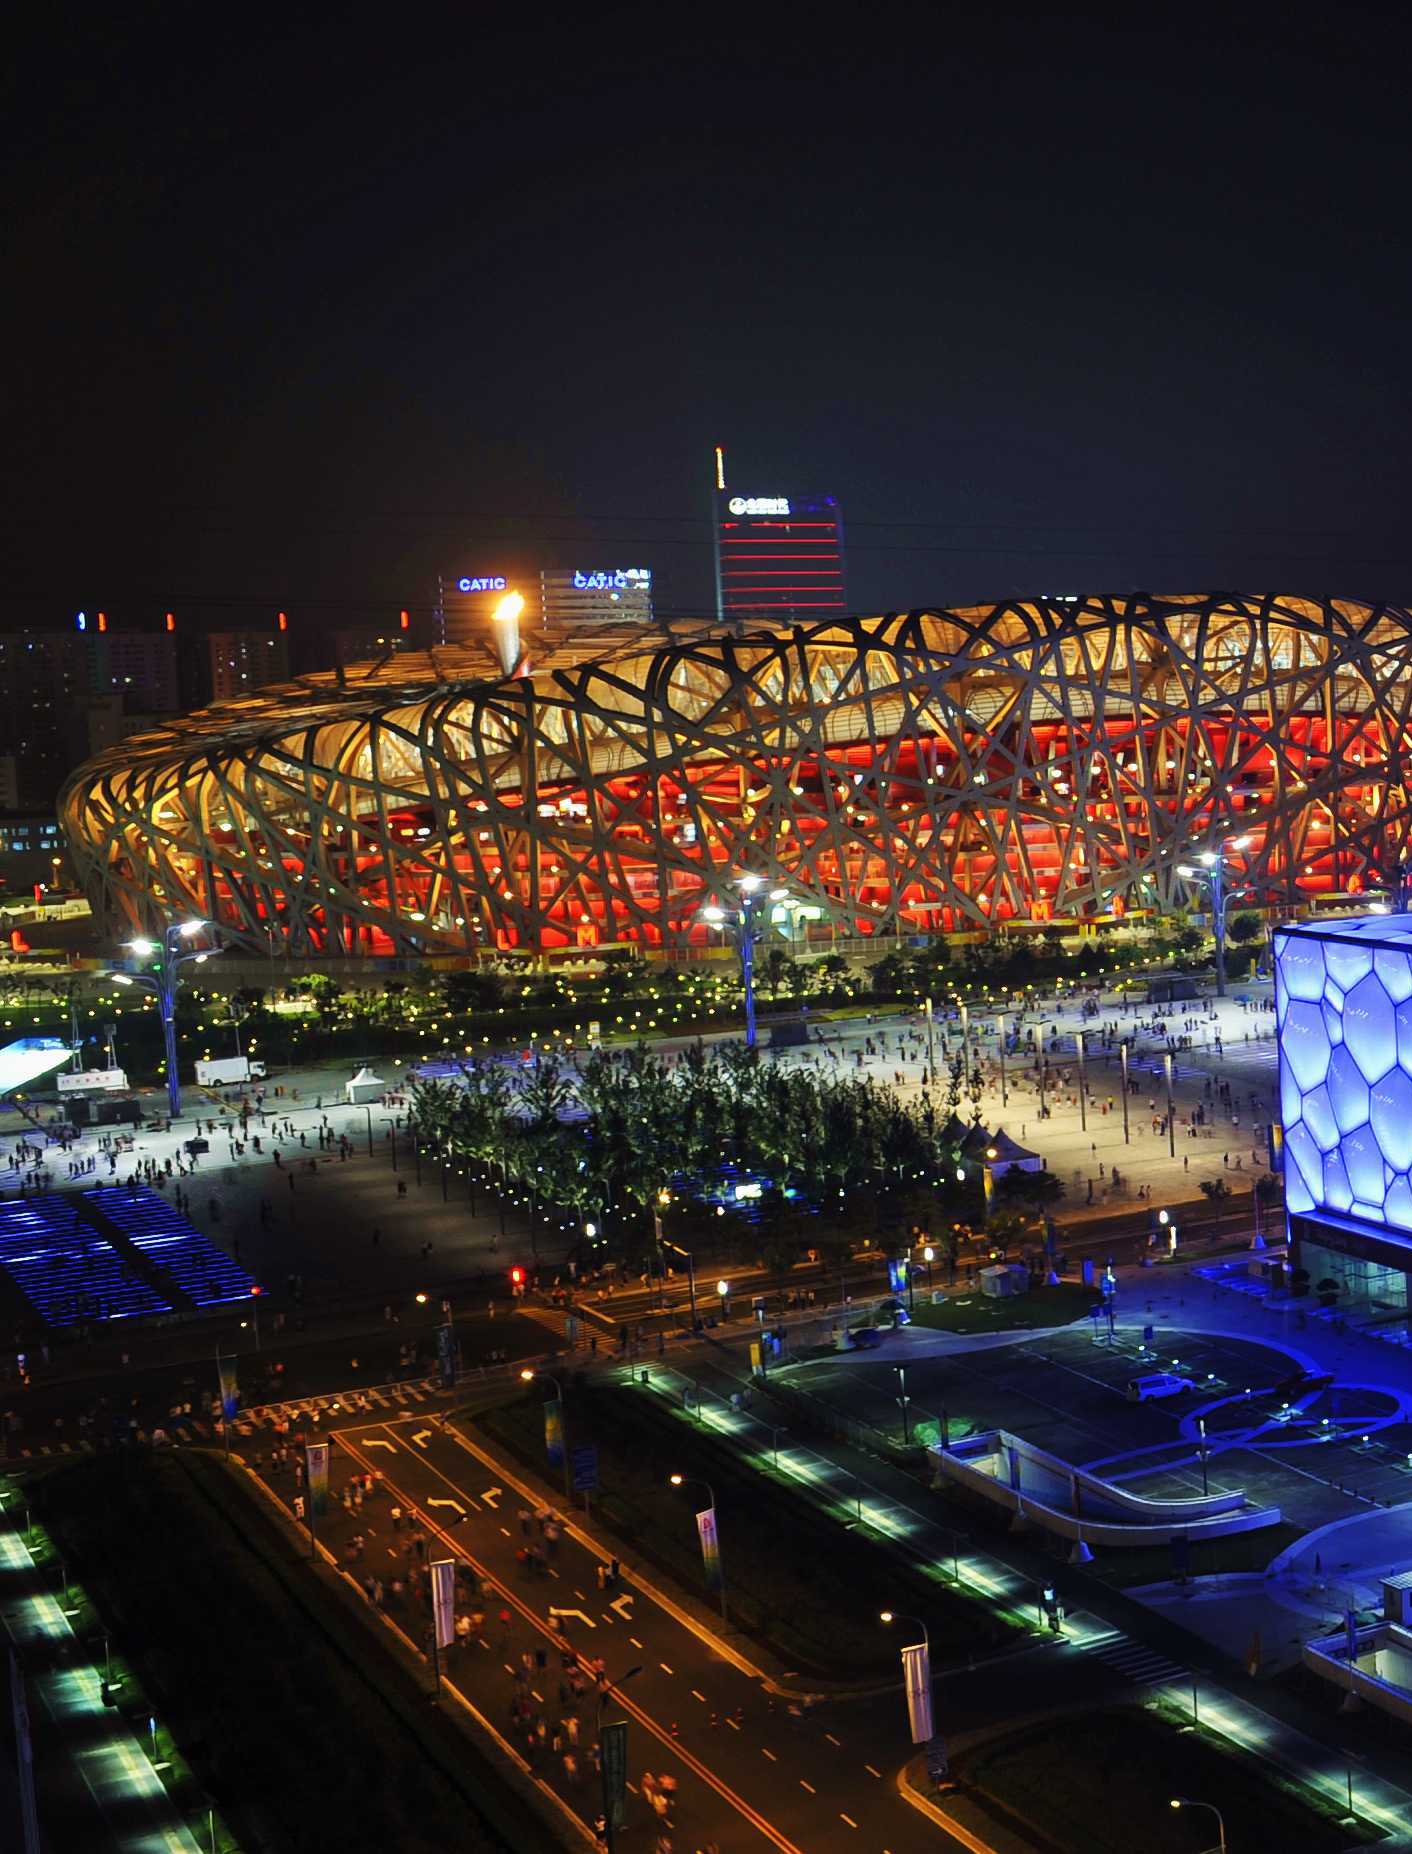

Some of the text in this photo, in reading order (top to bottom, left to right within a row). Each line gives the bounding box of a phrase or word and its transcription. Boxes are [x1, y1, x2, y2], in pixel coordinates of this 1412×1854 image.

[459, 577, 506, 592] CATIC
[574, 575, 627, 588] CATIC
[1031, 903, 1051, 922] M
[11, 930, 30, 953] L
[577, 925, 598, 947] M
